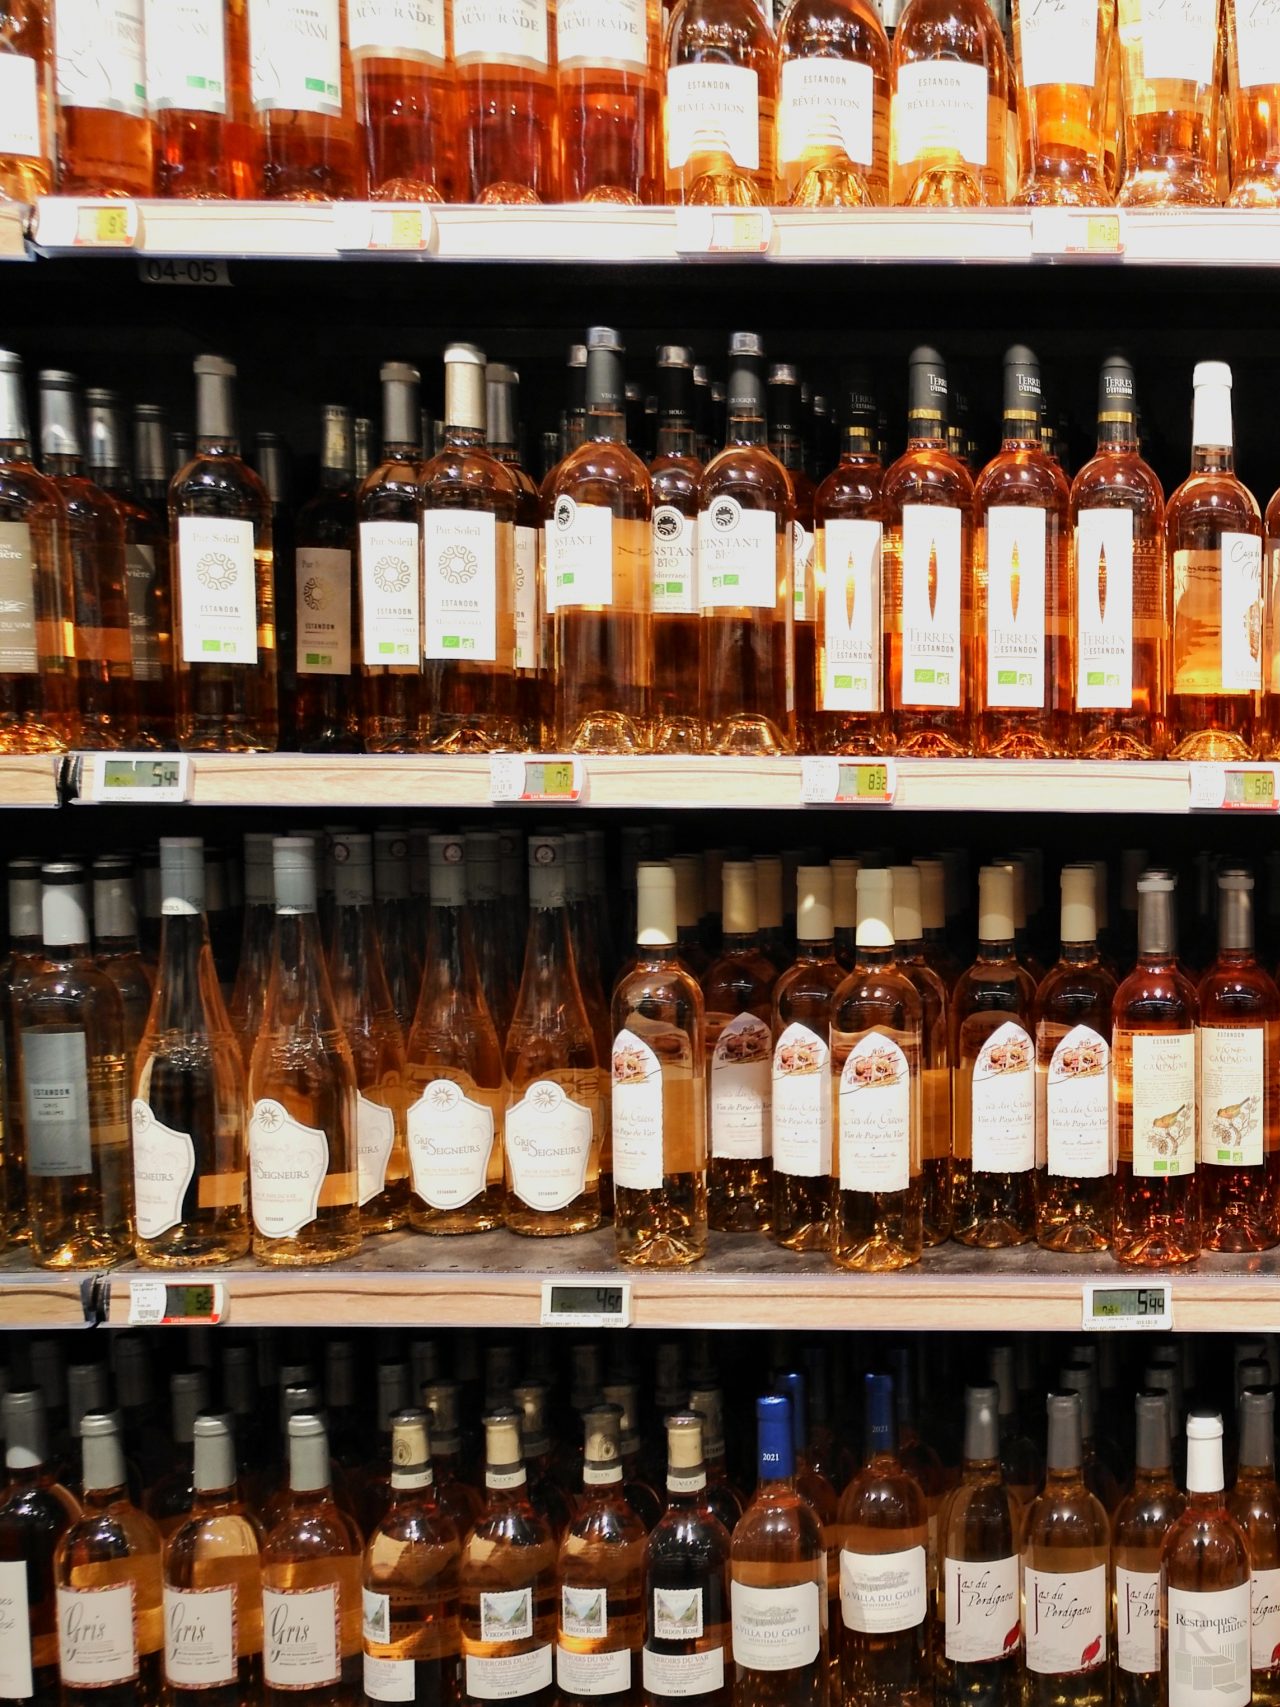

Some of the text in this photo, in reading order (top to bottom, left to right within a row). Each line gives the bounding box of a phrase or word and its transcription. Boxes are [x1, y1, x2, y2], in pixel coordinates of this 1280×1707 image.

[688, 80, 731, 91] ESTANDON
[803, 75, 847, 87] ESTANDON
[918, 77, 961, 87] ESTANDON
[147, 259, 218, 284] 04-05
[1104, 376, 1132, 388] TERRES
[441, 600, 479, 608] ESTANDON
[828, 636, 872, 651] TERRES
[909, 628, 955, 645] TERRES
[993, 629, 1038, 645] TERRES
[1082, 632, 1125, 646] TERRES
[762, 1453, 780, 1462] 2021
[852, 1592, 876, 1603] VILLA
[879, 1595, 894, 1604] DU
[1052, 1583, 1066, 1601] du
[64, 1602, 105, 1643] Gris
[168, 1602, 206, 1643] Gris
[270, 1603, 310, 1645] Gris
[1175, 1612, 1238, 1630] Restanques
[1218, 1620, 1248, 1634] Hautes
[764, 1630, 779, 1639] DU
